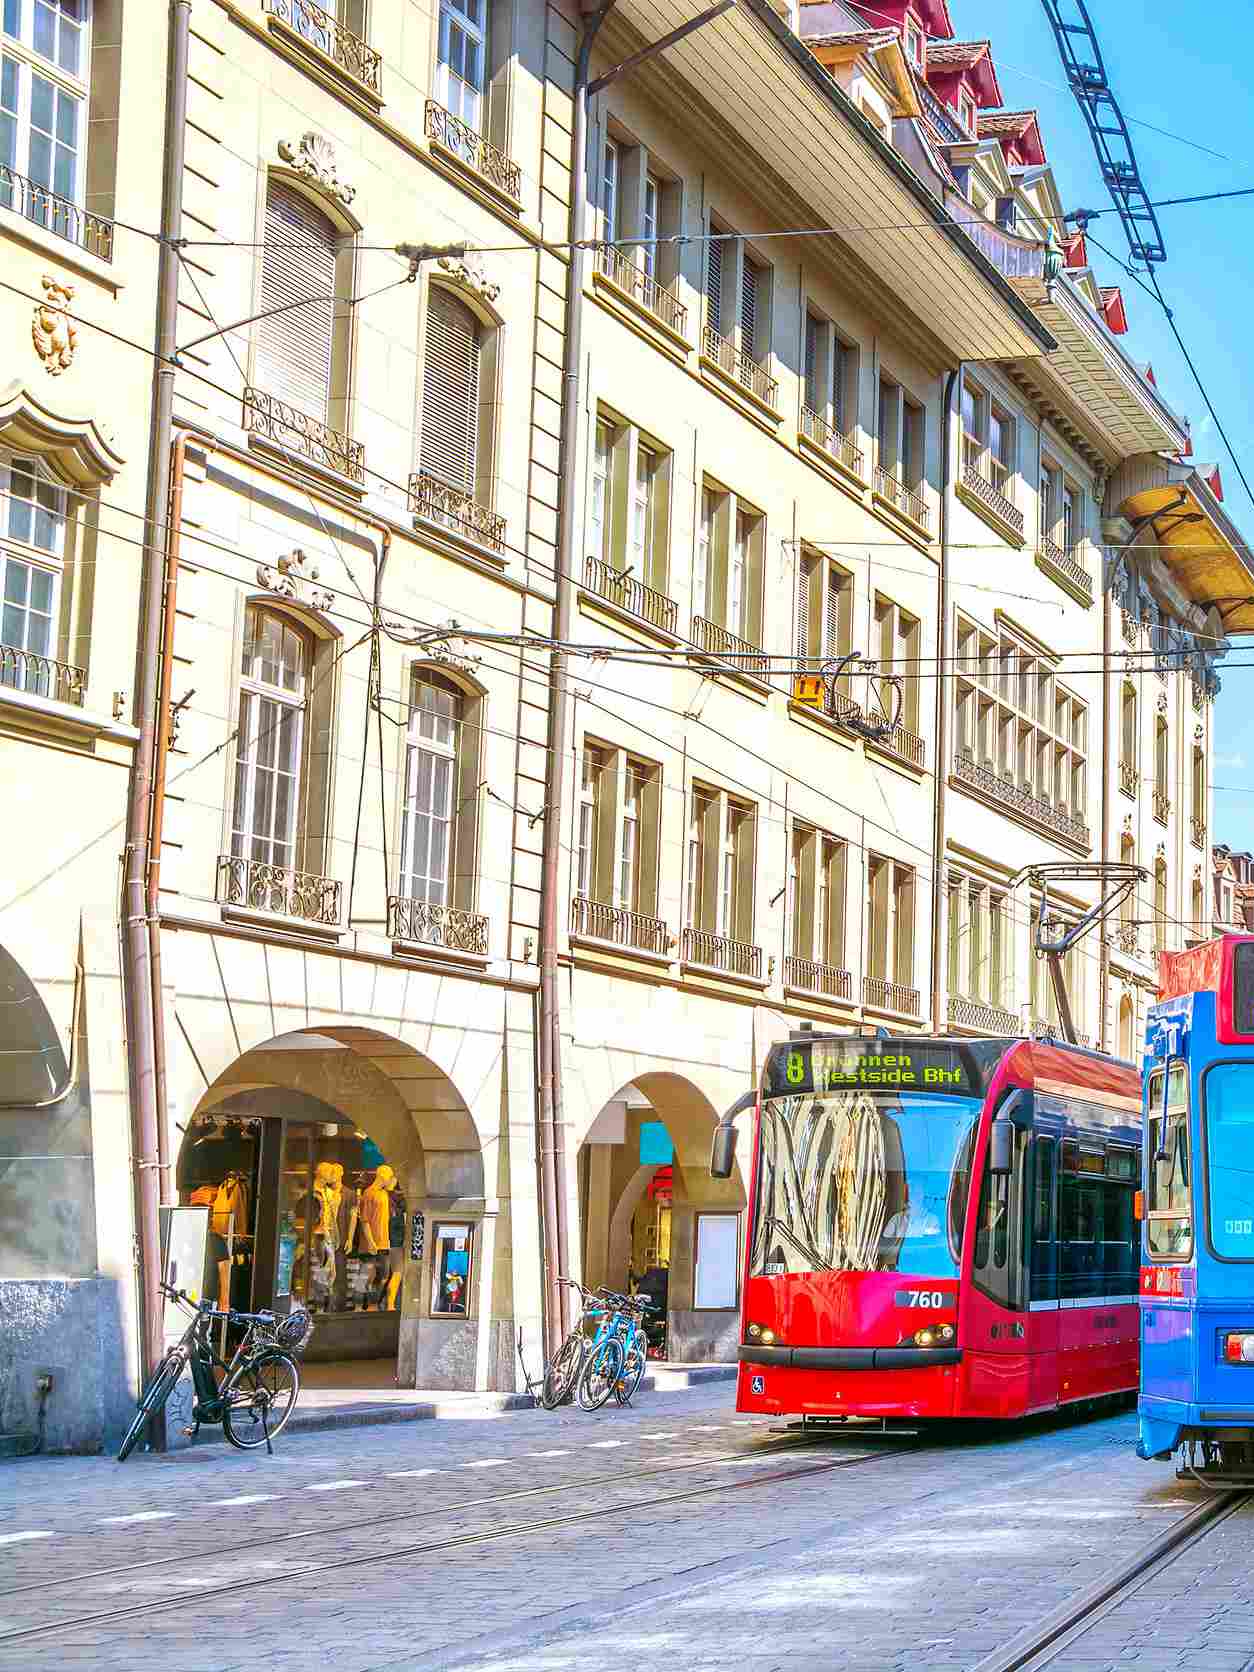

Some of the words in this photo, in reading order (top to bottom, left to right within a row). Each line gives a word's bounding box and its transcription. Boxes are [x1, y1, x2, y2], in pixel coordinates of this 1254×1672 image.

[787, 1054, 804, 1083] 8
[924, 1066, 961, 1082] Bhf
[908, 1291, 943, 1308] 760
